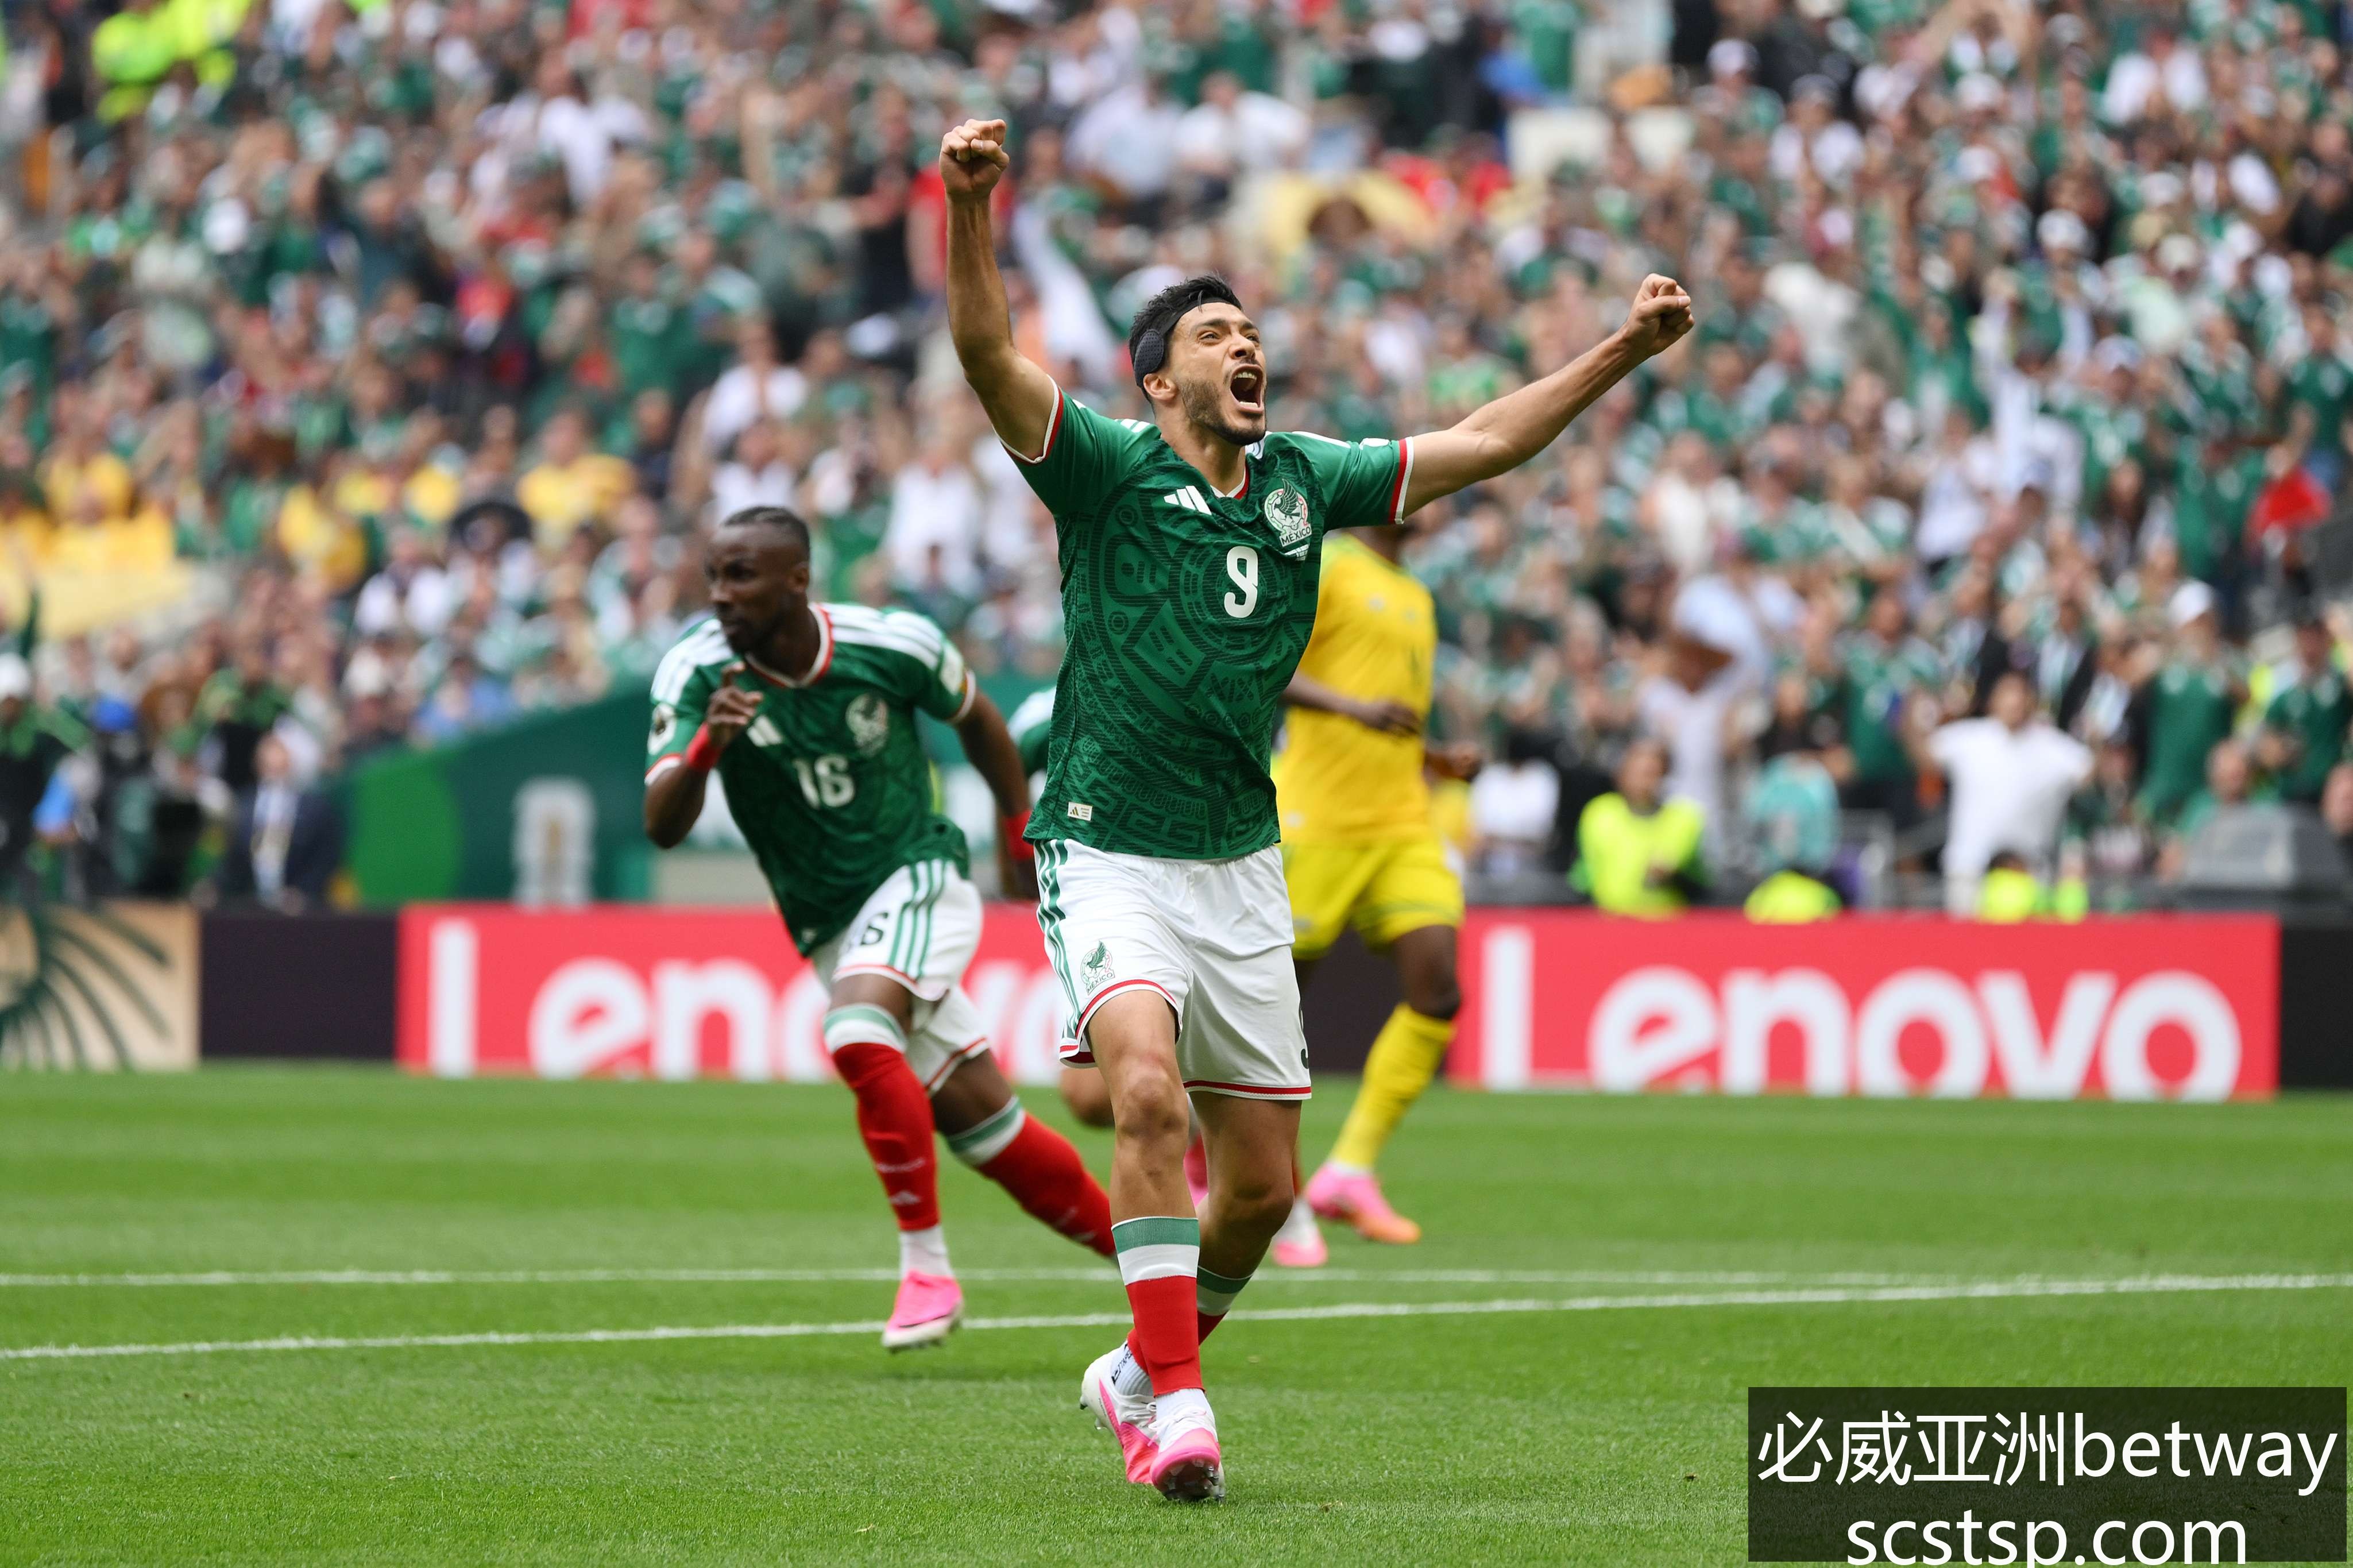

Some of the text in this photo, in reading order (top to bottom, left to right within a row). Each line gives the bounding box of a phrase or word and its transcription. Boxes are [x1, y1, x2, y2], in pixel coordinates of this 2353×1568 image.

[1224, 546, 1258, 619] 9
[793, 753, 855, 809] 16
[1481, 926, 2240, 1100] Lenovo
